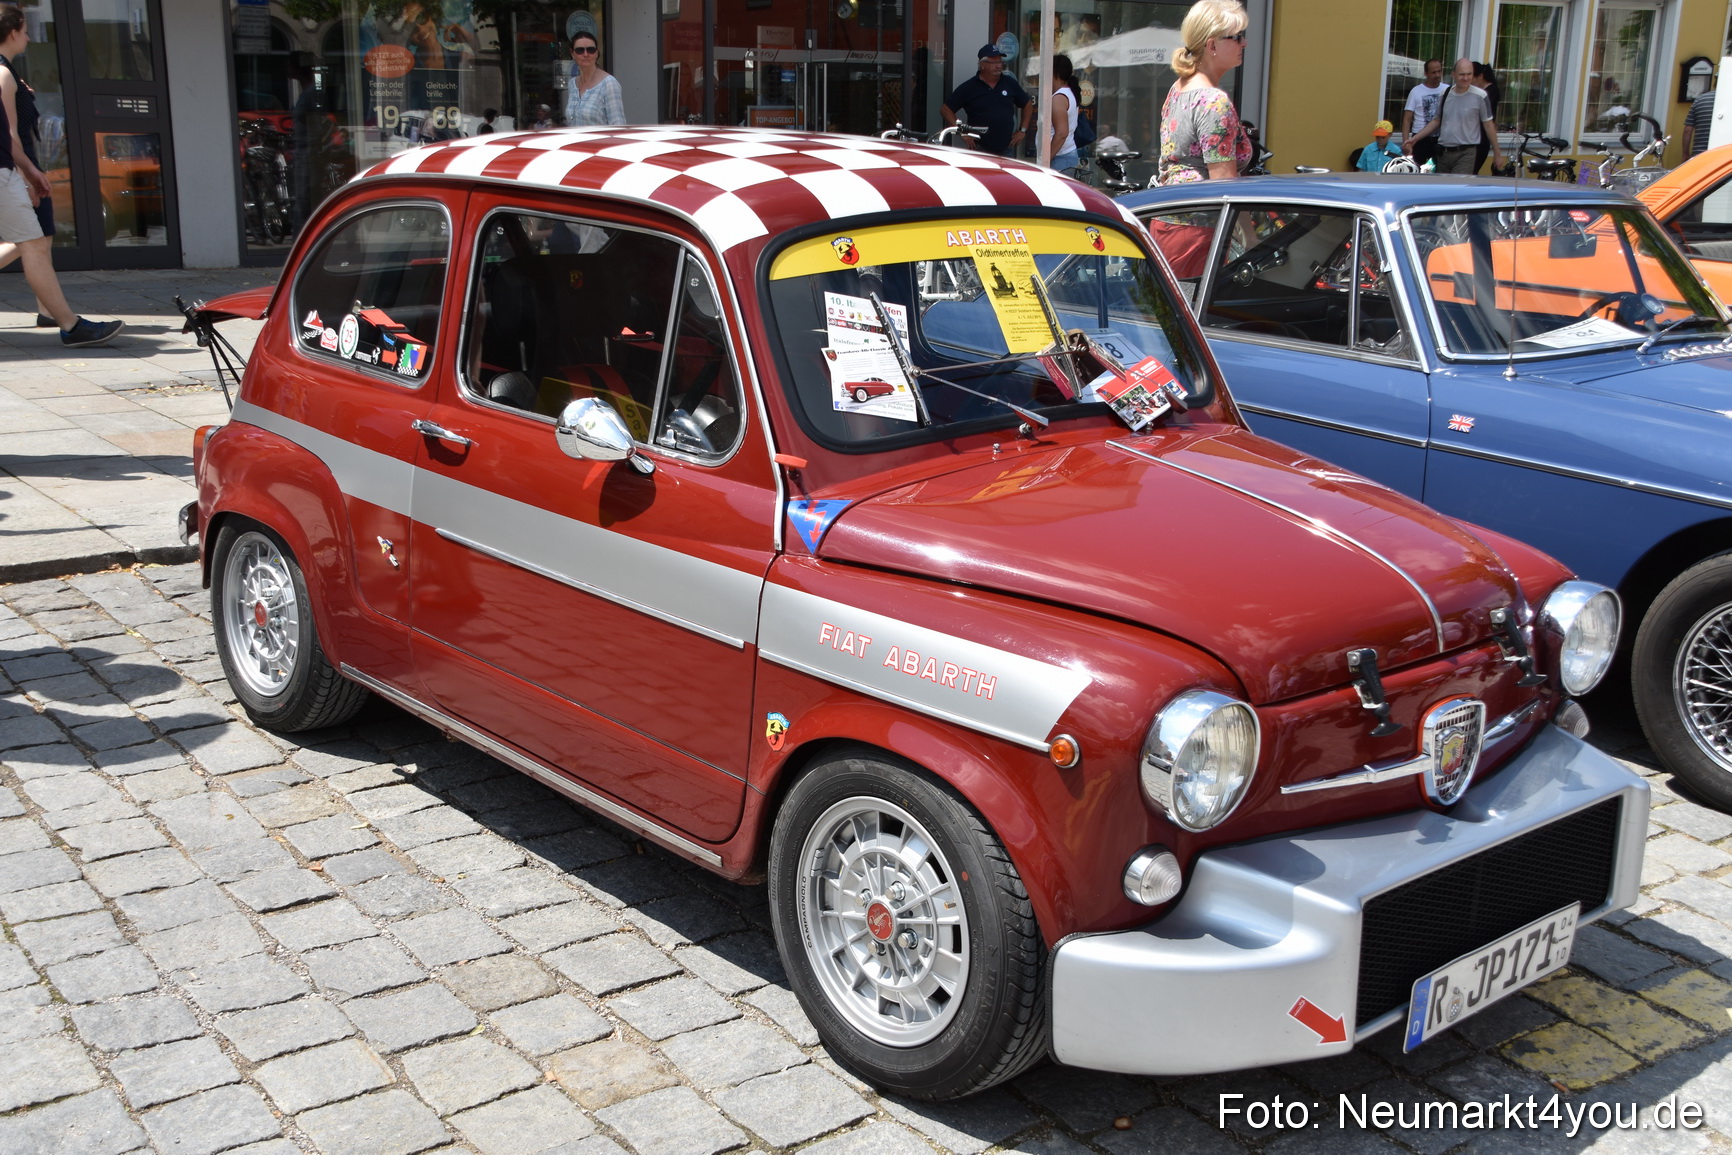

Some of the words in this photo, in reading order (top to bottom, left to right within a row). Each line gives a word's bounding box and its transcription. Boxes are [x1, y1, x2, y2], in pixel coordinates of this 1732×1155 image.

[369, 80, 387, 88] Fern-
[388, 80, 405, 88] oder
[426, 81, 458, 90] Gleitsicht-
[369, 89, 403, 97] Lesebrille
[755, 116, 796, 124] TOP-ANGEBOT
[945, 228, 1029, 247] ABARTH
[975, 248, 1030, 258] Oldtimertreffen
[830, 296, 845, 307] 10.
[818, 621, 872, 659] FIAT
[882, 645, 999, 701] ABARTH
[801, 876, 812, 948] CAMPAGNOLO
[1560, 914, 1574, 930] 04
[1555, 948, 1567, 962] 10
[1426, 975, 1449, 1031] R
[1467, 921, 1556, 1007] JP171
[1411, 1020, 1420, 1035] D
